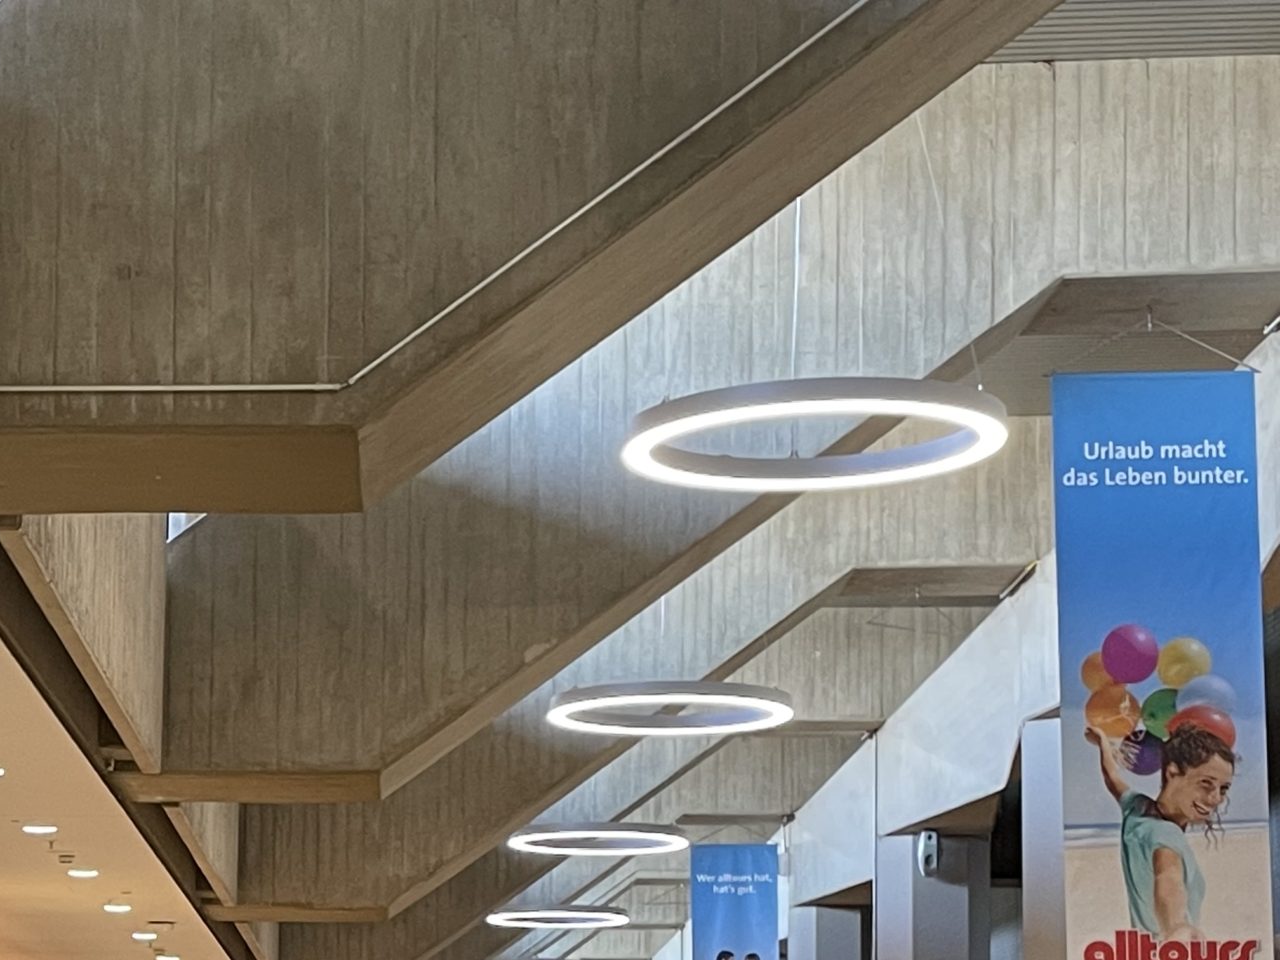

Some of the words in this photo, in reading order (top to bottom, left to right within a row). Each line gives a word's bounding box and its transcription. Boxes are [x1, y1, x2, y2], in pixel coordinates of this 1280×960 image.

[1083, 440, 1154, 460] Urlaub
[1160, 439, 1227, 458] macht
[1062, 467, 1099, 486] das
[1104, 466, 1167, 486] Leben
[1173, 465, 1249, 485] bunter.
